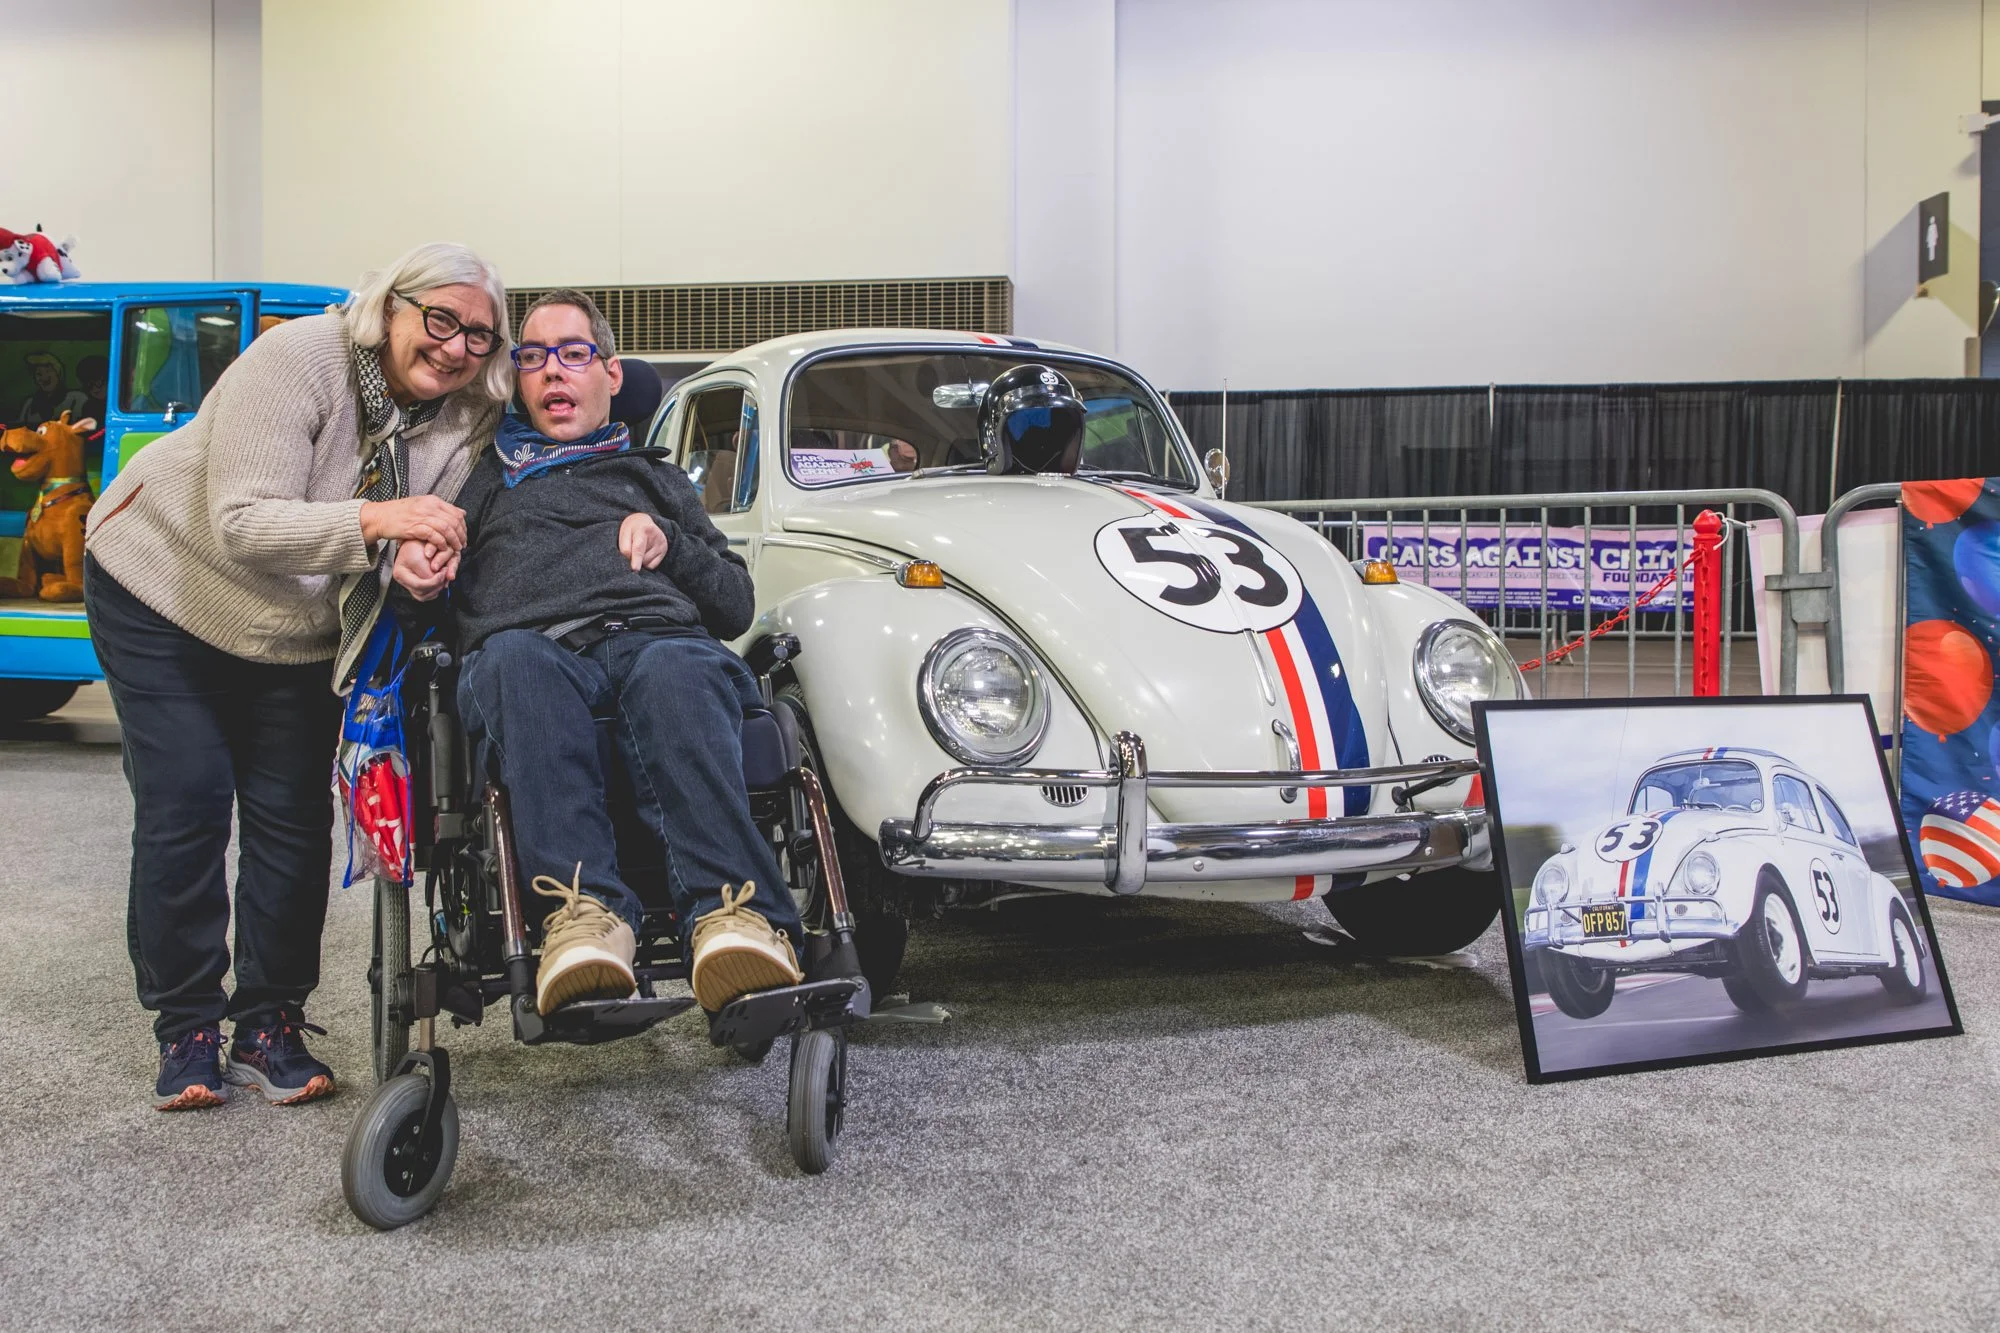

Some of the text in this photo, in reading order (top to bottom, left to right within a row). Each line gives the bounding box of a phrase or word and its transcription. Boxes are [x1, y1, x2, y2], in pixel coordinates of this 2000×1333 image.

[1117, 521, 1289, 607] 53
[1379, 545, 1458, 567] CARS
[1465, 545, 1594, 569] AGAINST
[1603, 571, 1694, 584] FOUDAT
[1601, 821, 1660, 851] 53
[1812, 869, 1840, 923] 53
[1583, 911, 1625, 933] OFP 857
